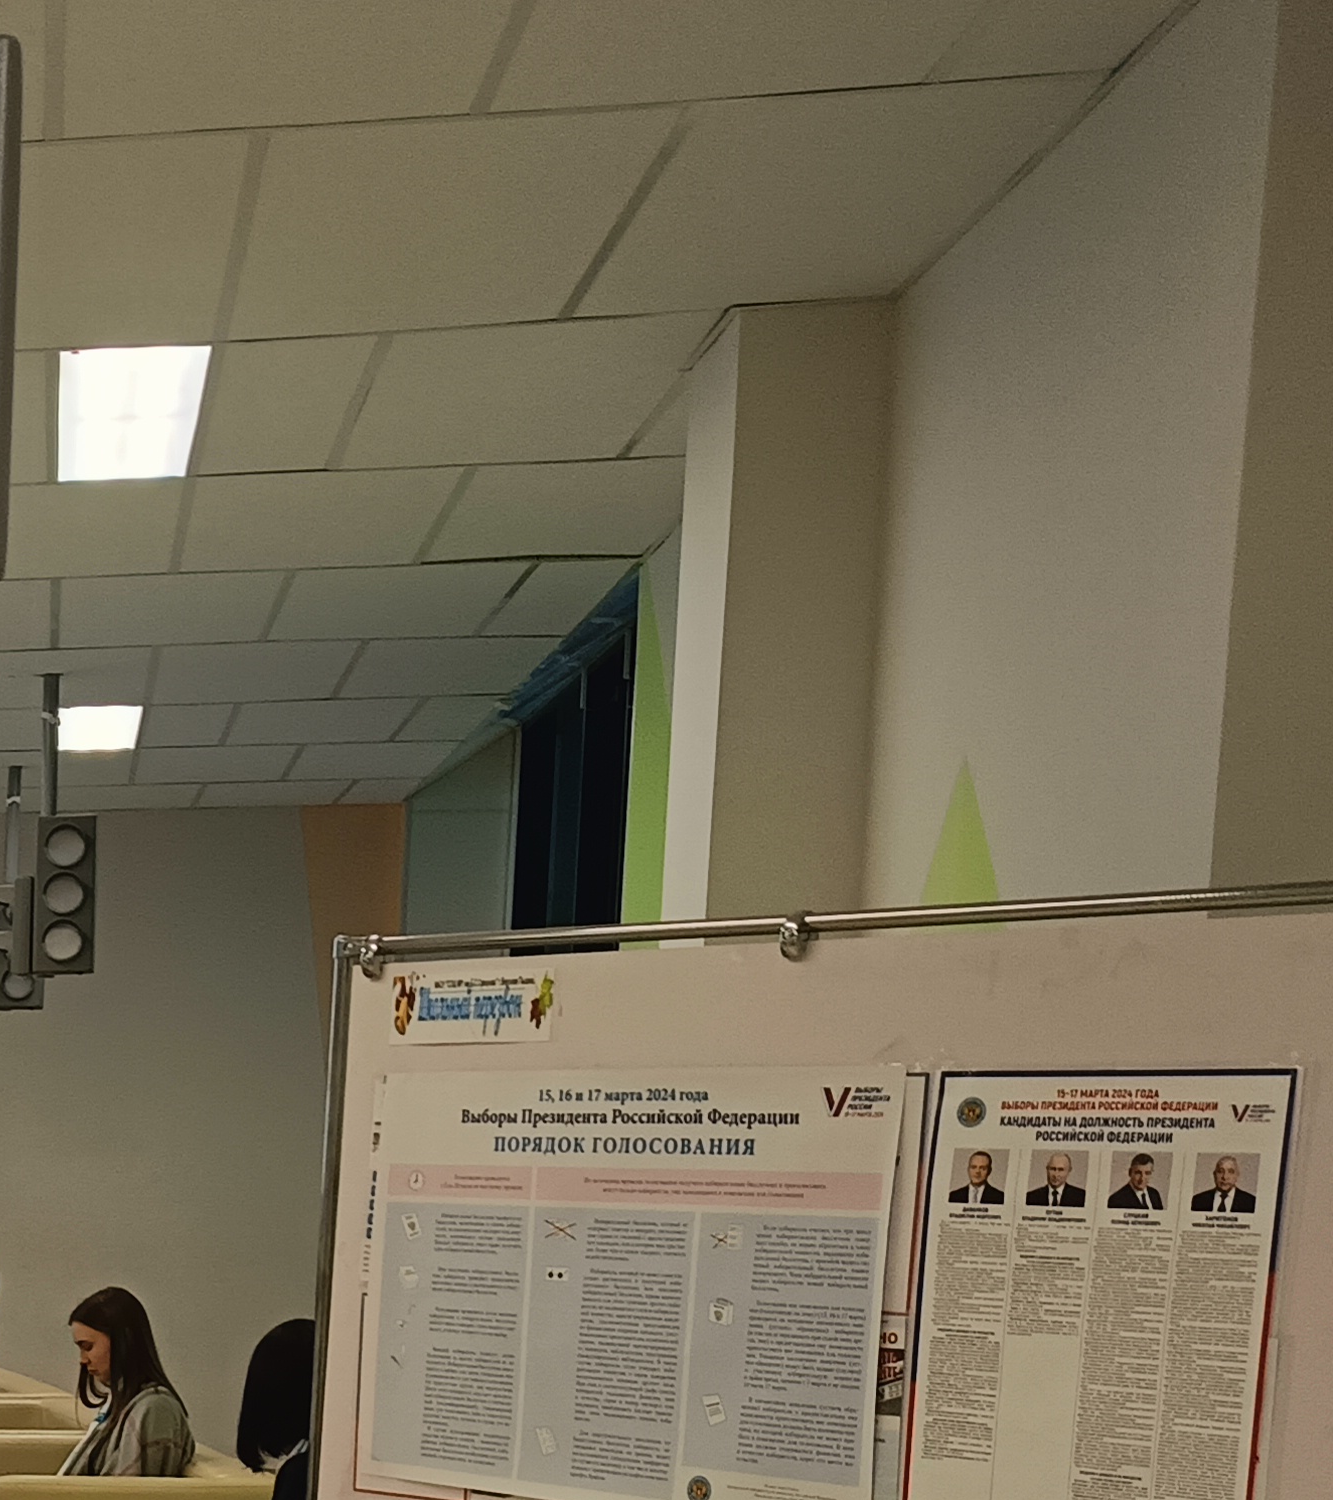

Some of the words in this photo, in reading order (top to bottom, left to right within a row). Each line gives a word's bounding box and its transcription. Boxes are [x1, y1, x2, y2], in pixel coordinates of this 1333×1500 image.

[538, 1089, 555, 1104] 15,
[559, 1089, 572, 1101] 16
[575, 1092, 583, 1101] и
[588, 1089, 601, 1101] 17
[604, 1092, 642, 1105] марта
[646, 1089, 676, 1101] 2024
[679, 1091, 709, 1103] года
[1080, 1089, 1109, 1098] МАРТА
[1111, 1089, 1133, 1098] 2024
[1135, 1089, 1159, 1099] ГОДА
[1001, 1100, 1039, 1110] ВЫБОРЫ
[1041, 1101, 1096, 1111] ПРЕЗИДЕНТА
[1098, 1100, 1159, 1111] РОССИЙСКОЙ
[1161, 1101, 1218, 1112] ФЕДЕРАЦИИ
[461, 1109, 518, 1127] Выборы
[521, 1109, 607, 1127] Президента
[612, 1108, 703, 1125] Российской
[707, 1110, 800, 1129] Федерации
[1000, 1116, 1062, 1127] КАНДИДАТЫ
[1064, 1117, 1077, 1127] НА
[1079, 1117, 1145, 1129] ДОЛЖНОСТЬ
[1146, 1117, 1216, 1129] ПРЕЗИДЕНТА
[1036, 1130, 1104, 1142] РОССИЙСКОЙ
[1107, 1131, 1173, 1143] ФЕДЕРАЦИИ
[494, 1136, 586, 1155] ПОРЯДОК
[592, 1137, 756, 1156] ГОЛОСОВАНИЯ
